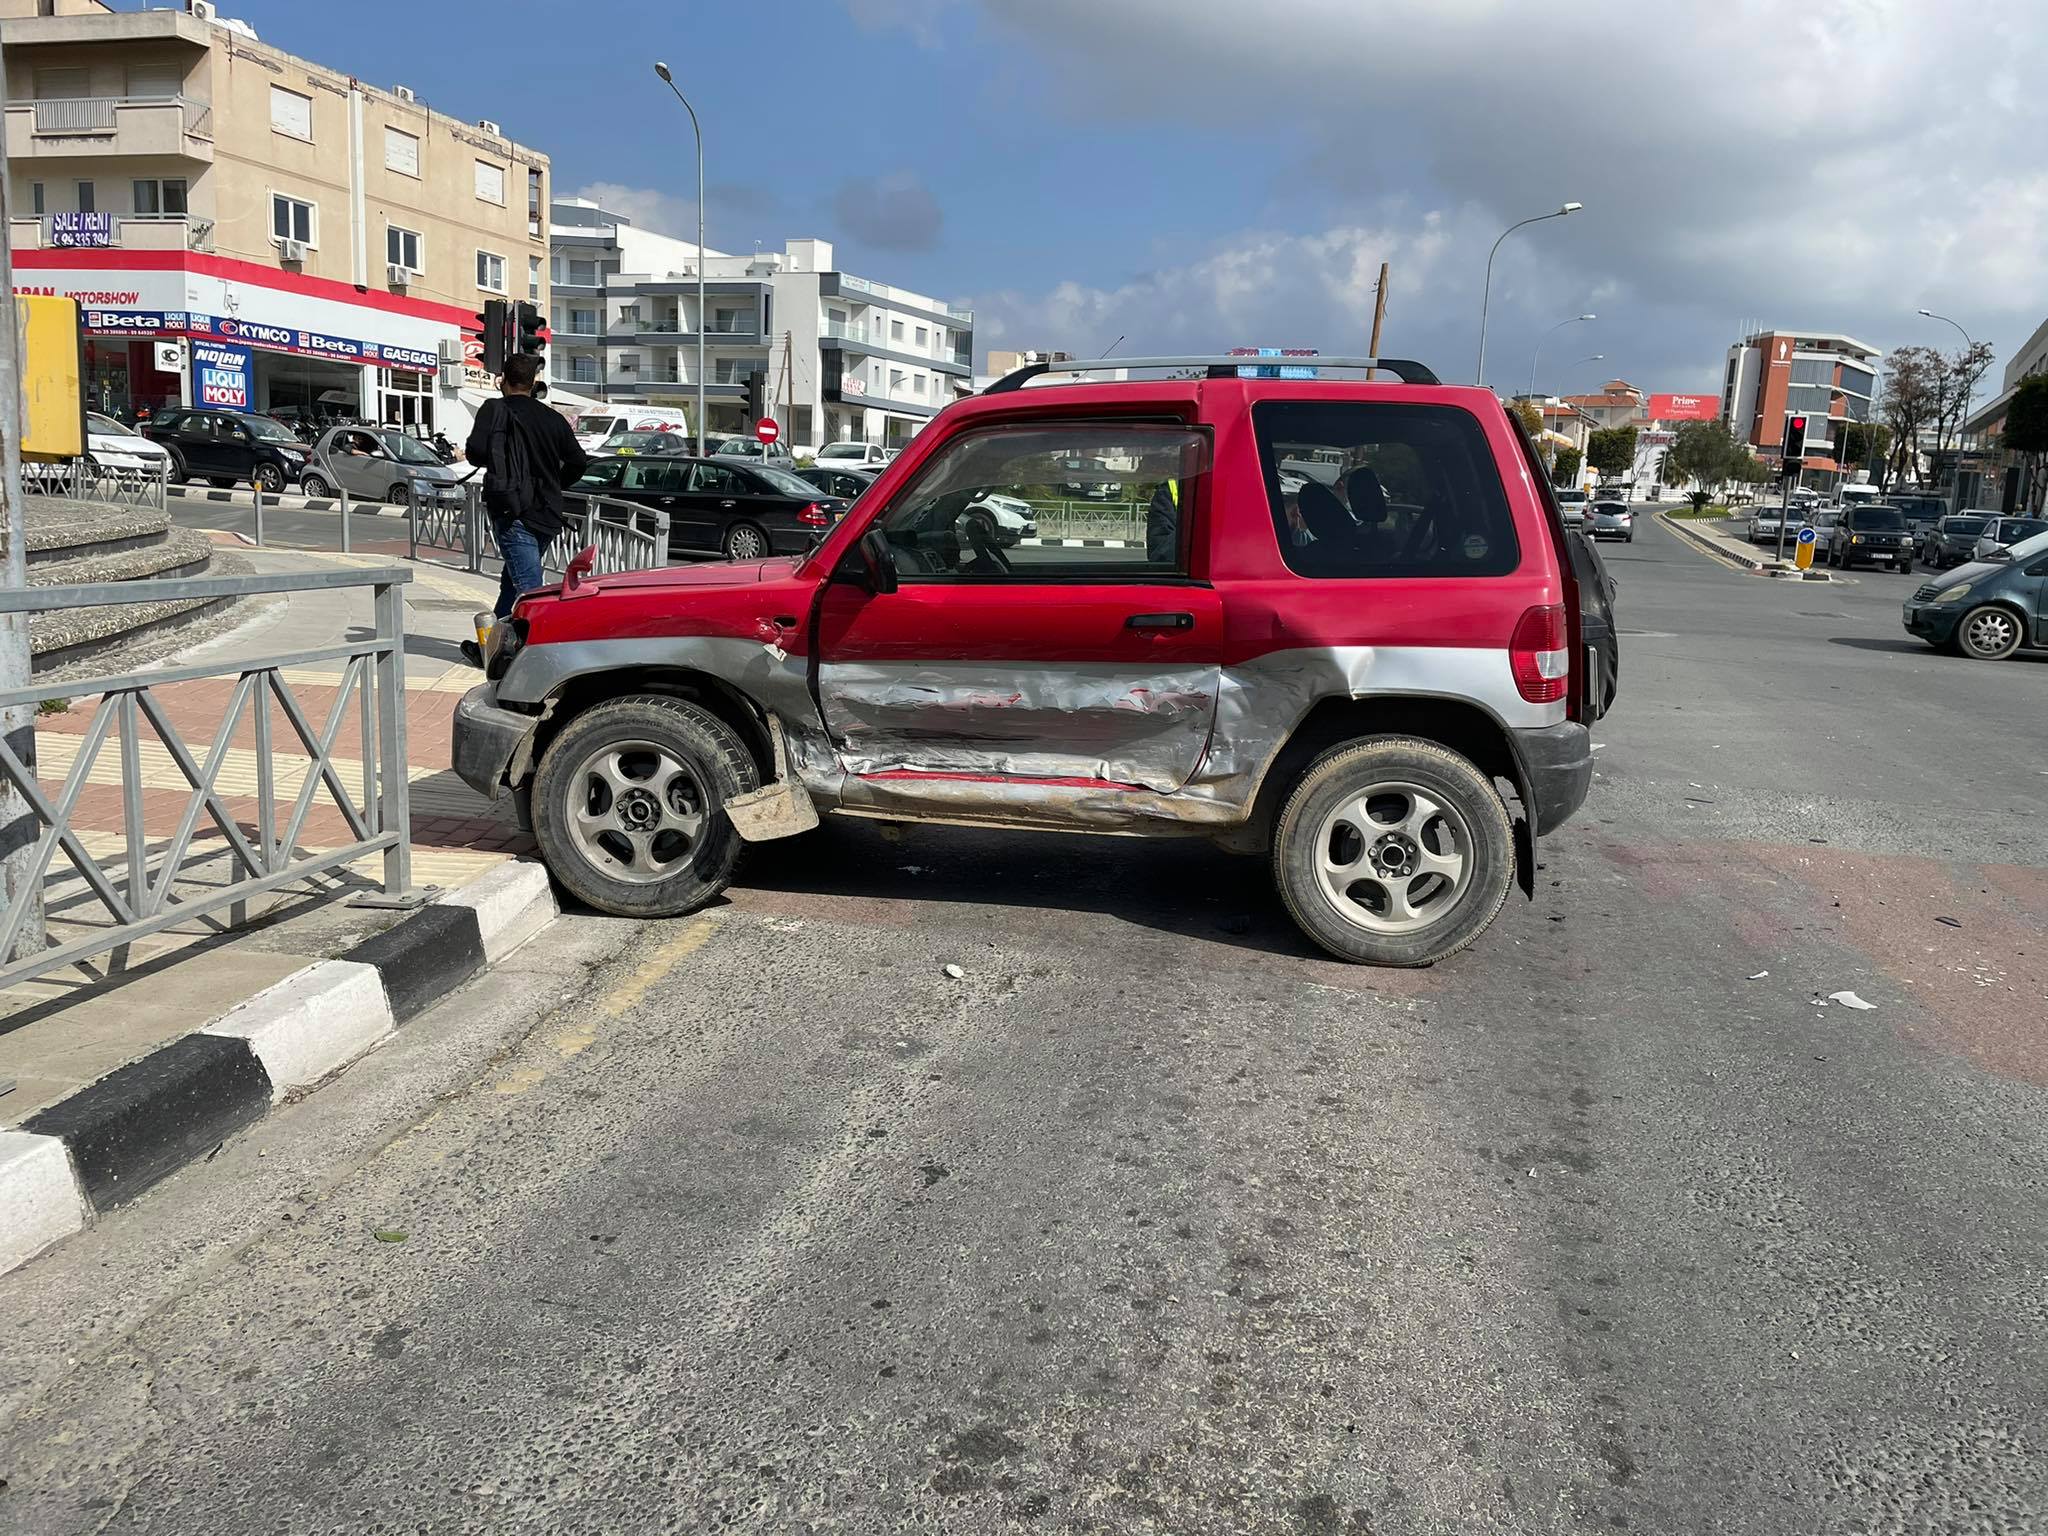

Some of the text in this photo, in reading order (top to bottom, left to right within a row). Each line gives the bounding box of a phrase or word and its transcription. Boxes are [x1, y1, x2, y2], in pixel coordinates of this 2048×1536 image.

[61, 233, 109, 246] 99 335 394
[102, 313, 160, 328] Beta
[164, 312, 184, 321] LIQUI
[164, 321, 184, 329] MOLY
[191, 323, 211, 332] MOLY
[239, 323, 291, 344] KYMCO
[311, 335, 358, 354] Beta
[194, 349, 246, 368] NOLAN
[383, 347, 436, 366] GASGAS
[205, 370, 243, 389] LIQUI
[205, 386, 245, 404] MOLY
[1672, 395, 1697, 406] Prime
